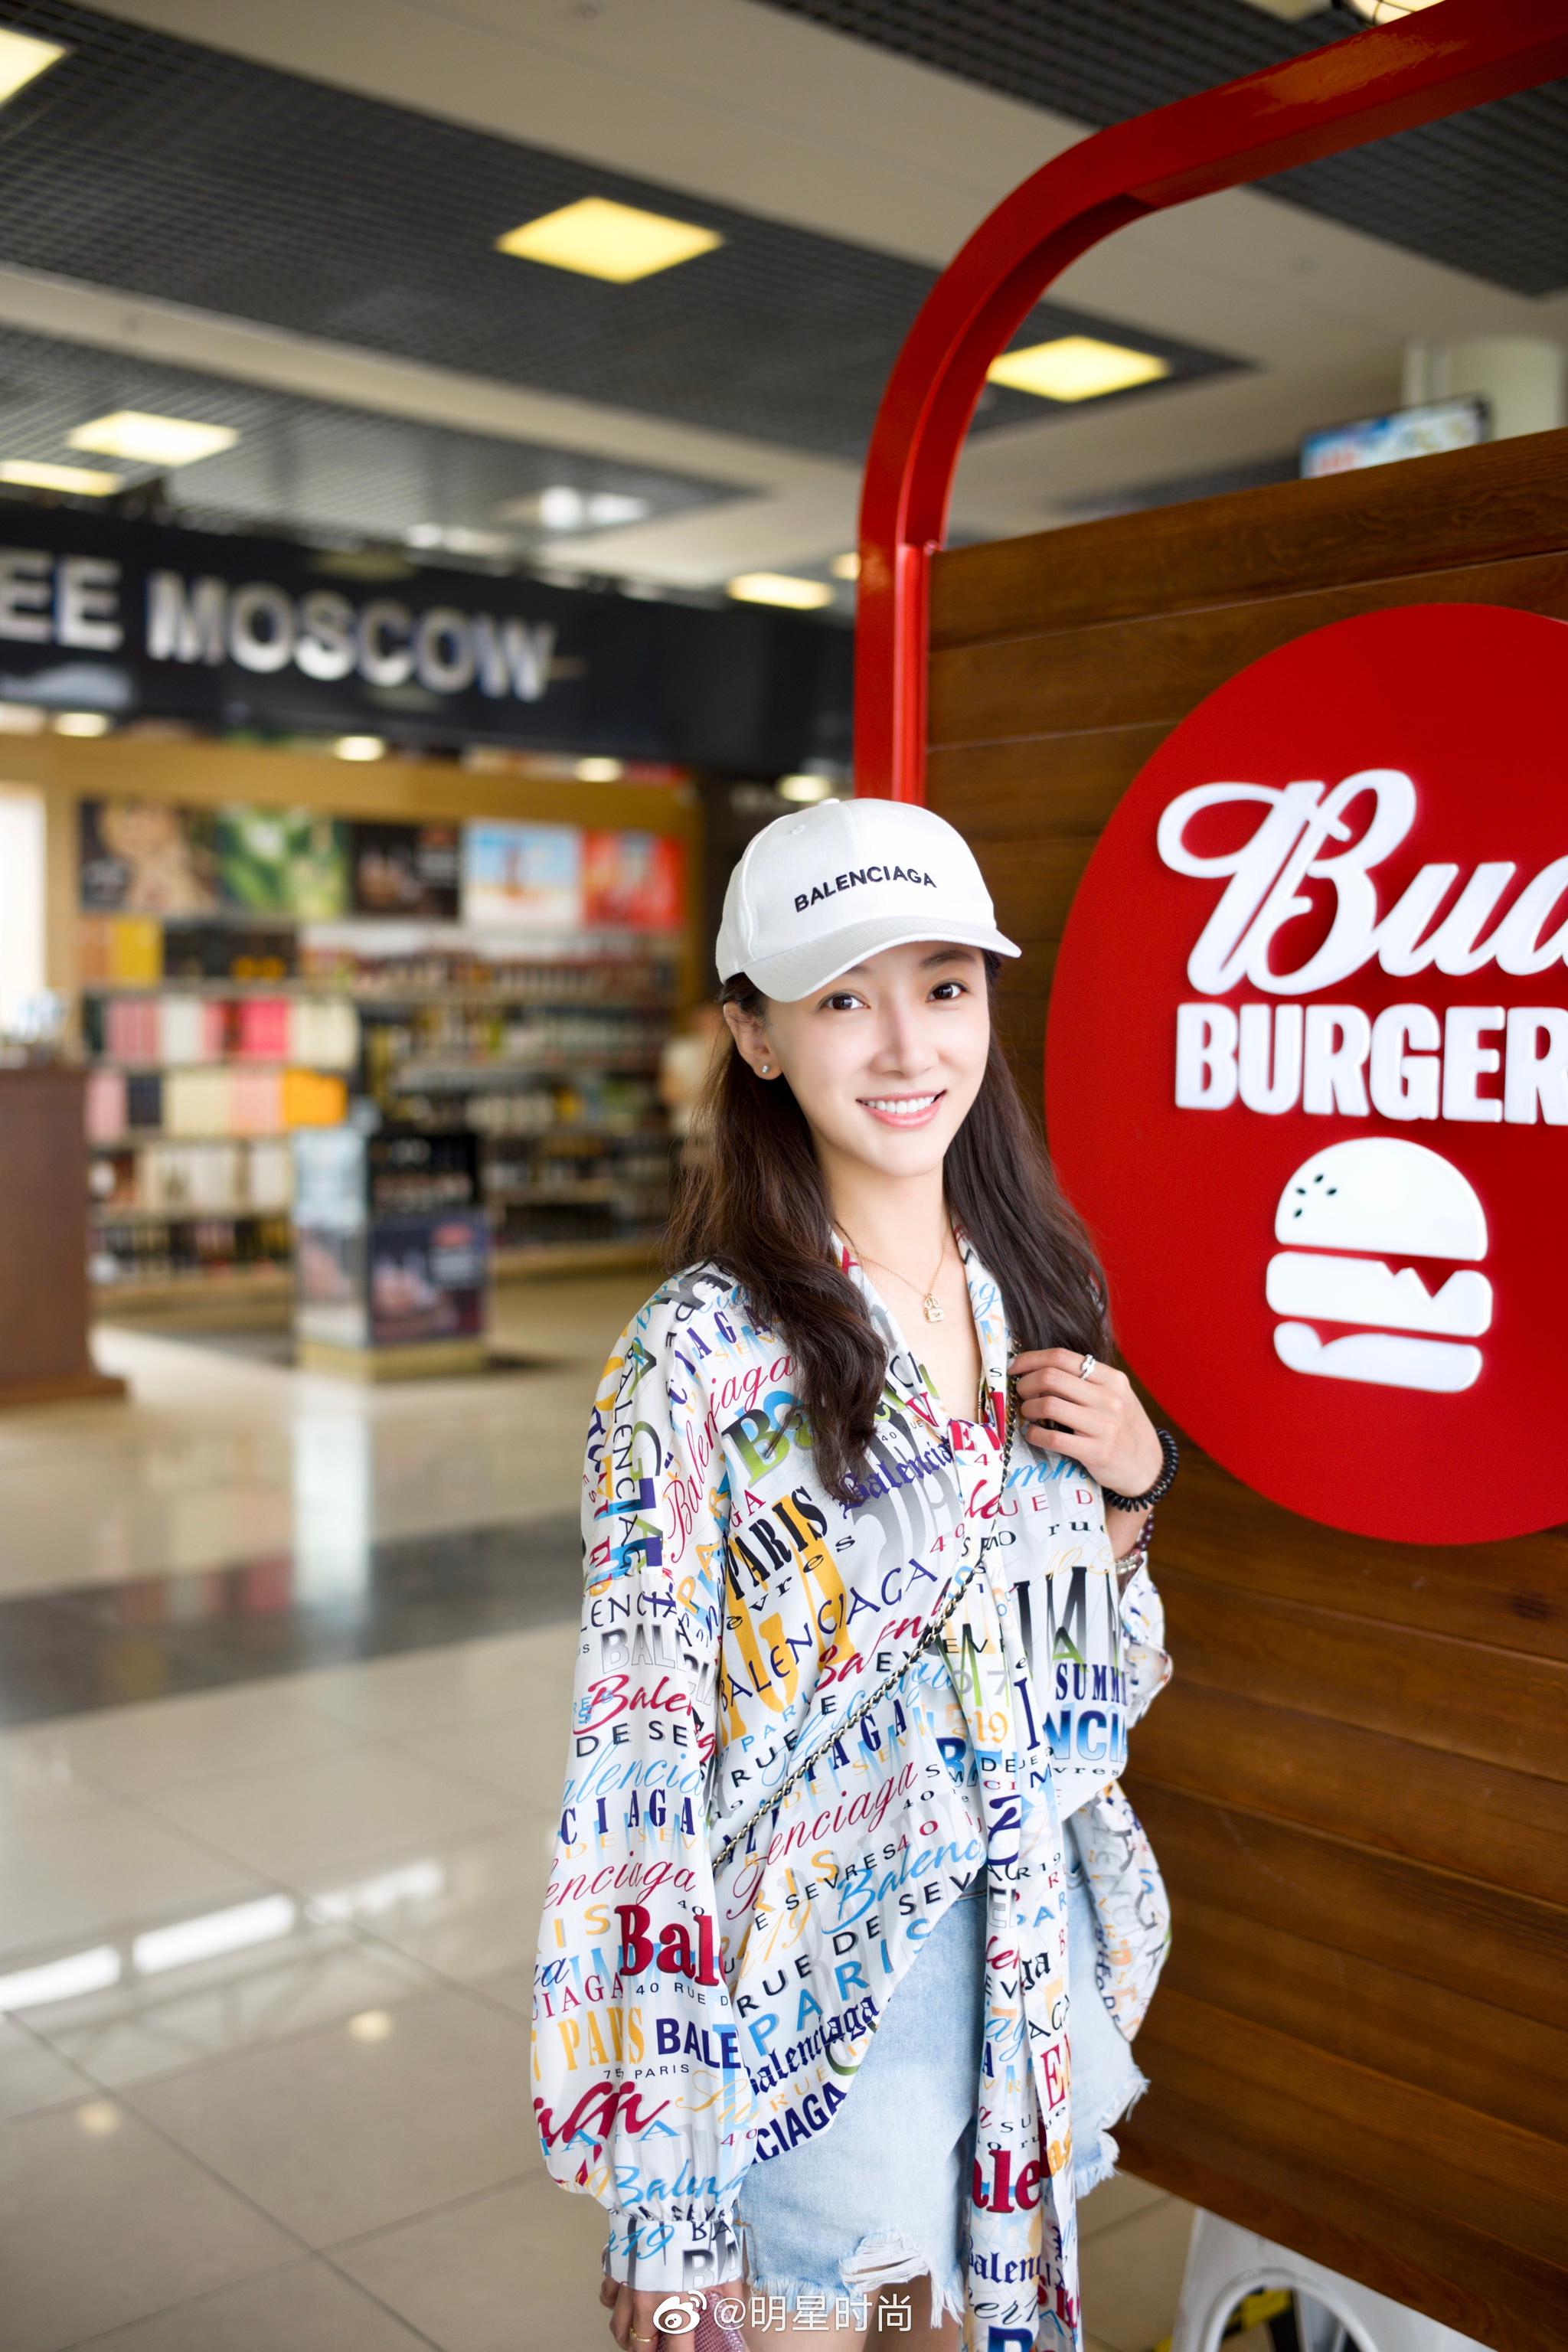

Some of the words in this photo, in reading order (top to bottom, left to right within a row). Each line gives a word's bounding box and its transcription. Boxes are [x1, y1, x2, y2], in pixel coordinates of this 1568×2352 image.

[145, 570, 558, 703] MOSCOW
[795, 866, 936, 912] BALENCIAGA
[727, 1485, 828, 1601] PARIS
[786, 1843, 897, 1911] SEVRES
[636, 1982, 659, 1996] 40
[675, 1982, 706, 2004] RUE
[737, 1953, 814, 2020] RUE
[832, 1915, 884, 1956] DE
[635, 2064, 690, 2079] PARIS
